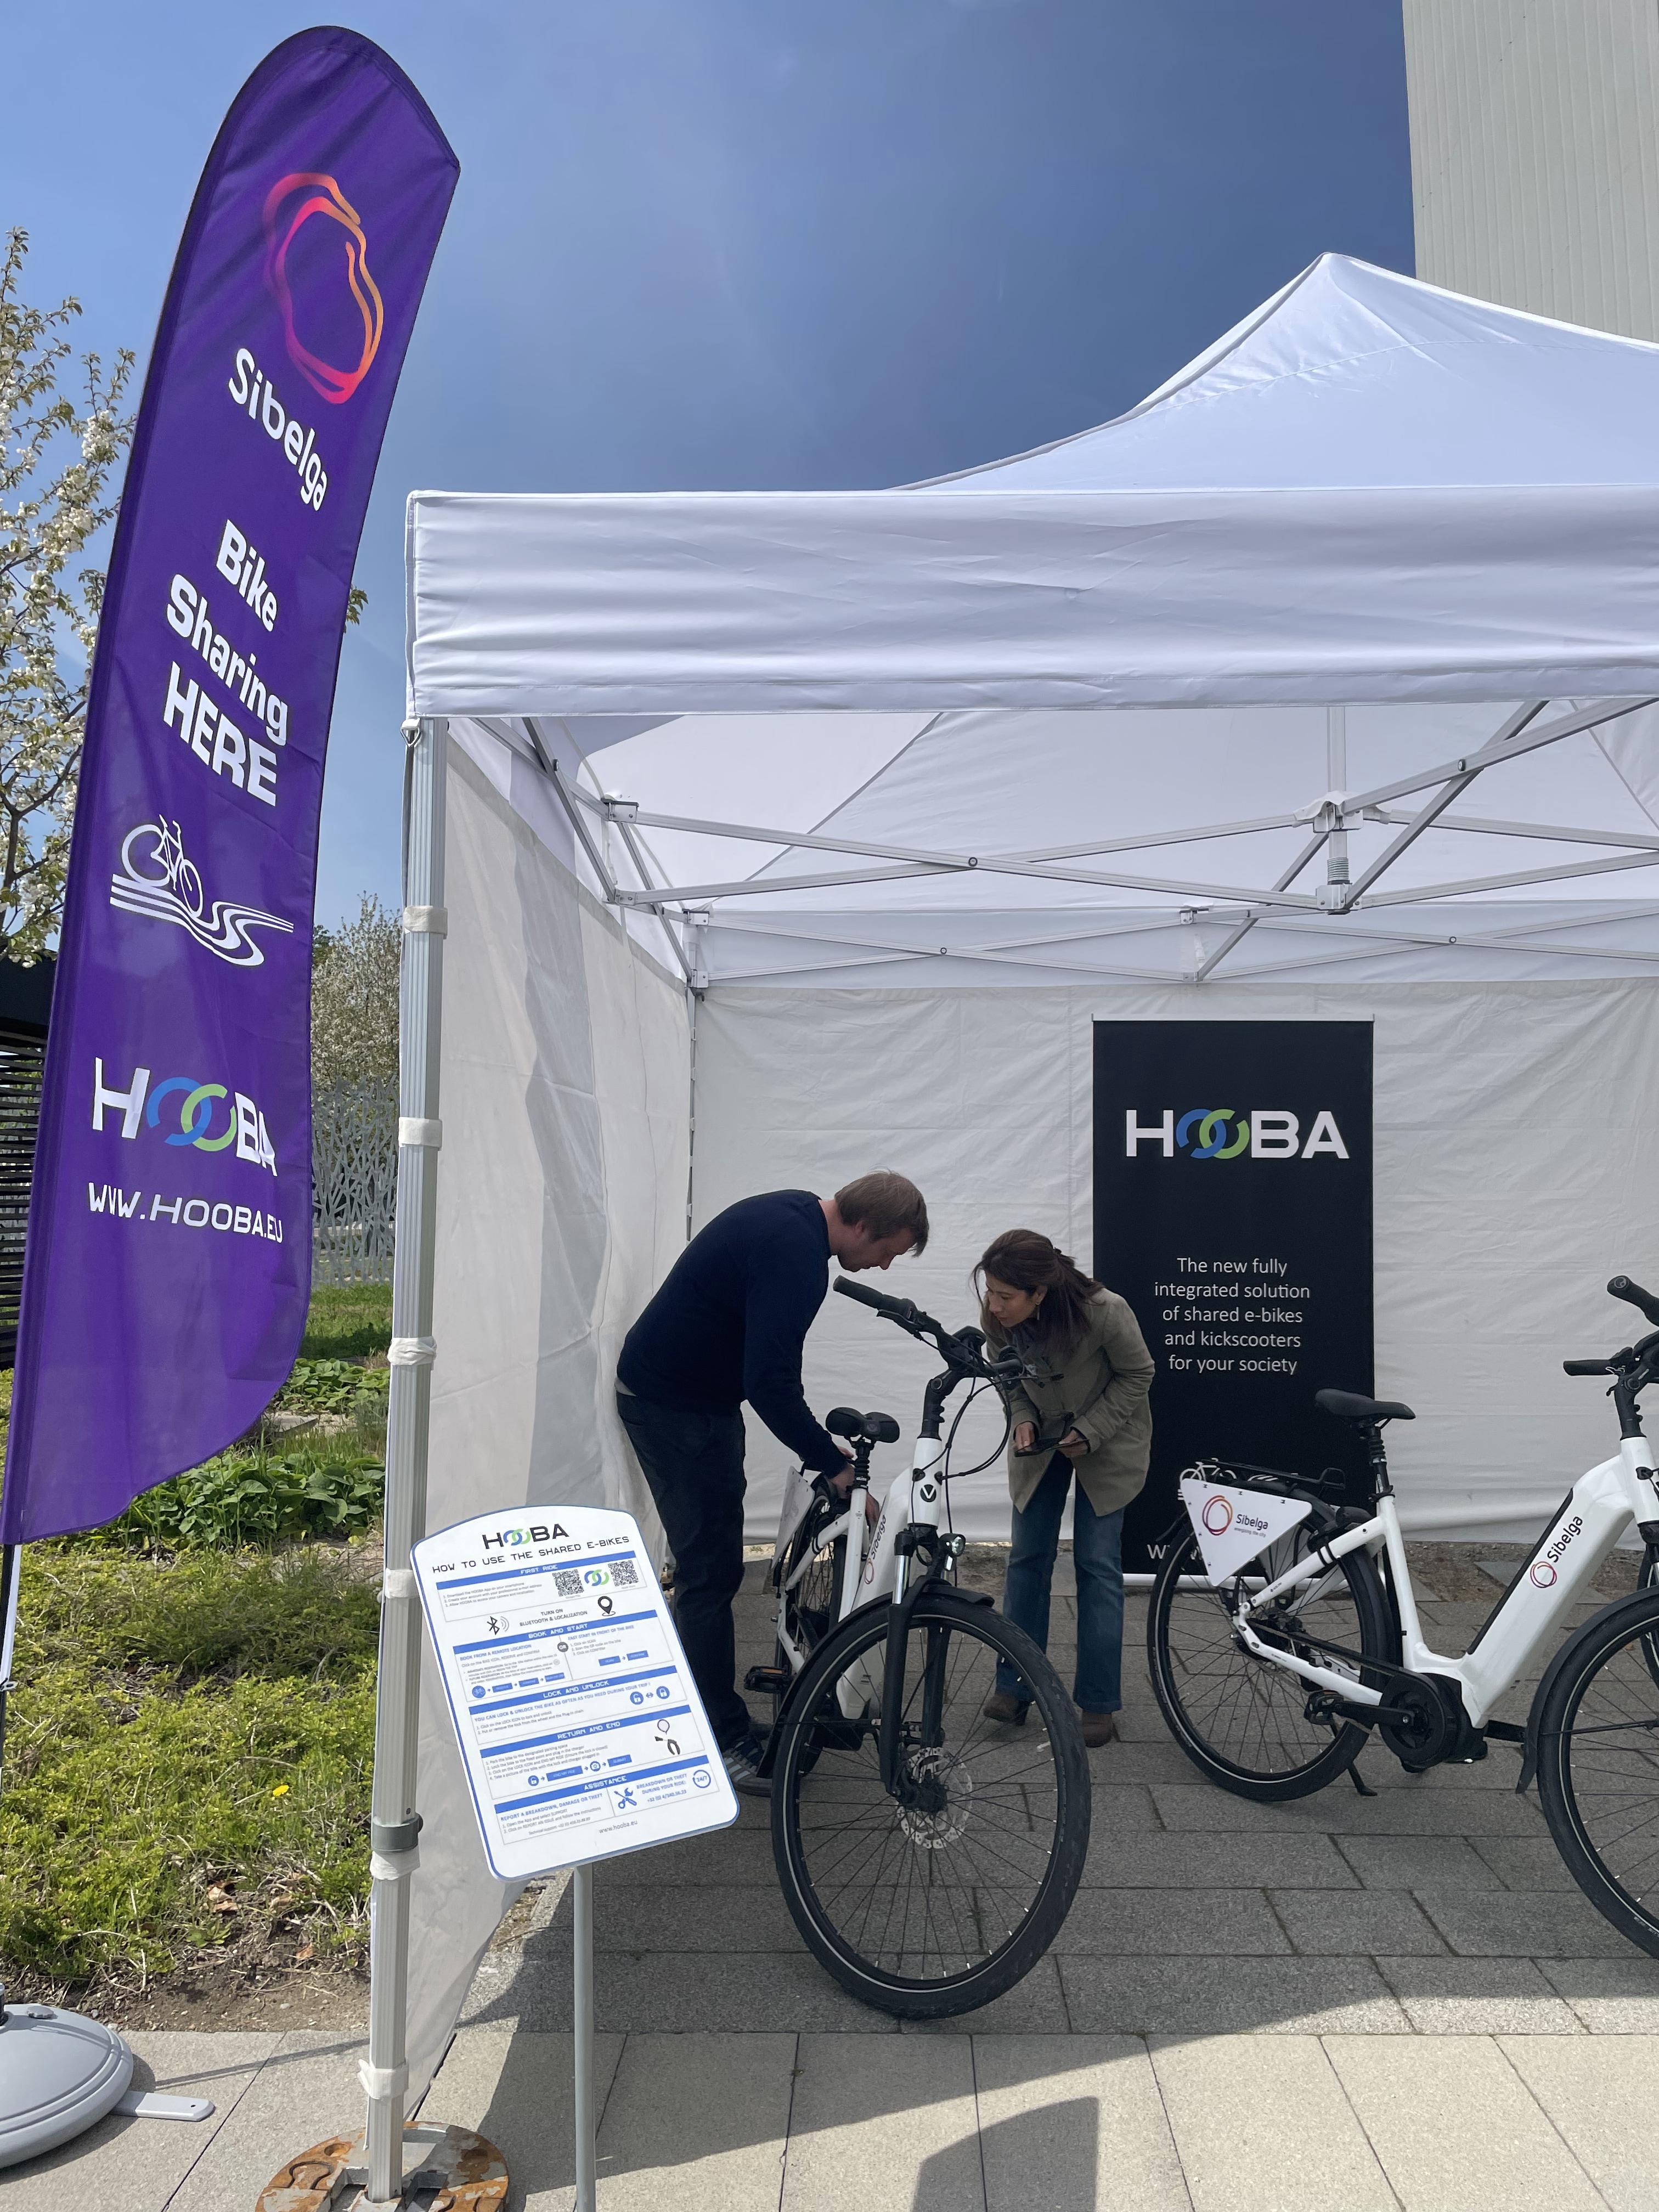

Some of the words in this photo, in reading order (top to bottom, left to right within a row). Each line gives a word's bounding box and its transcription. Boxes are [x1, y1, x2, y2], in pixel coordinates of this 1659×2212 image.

[228, 348, 328, 511] Sibelga
[216, 519, 278, 632] Bike
[167, 574, 289, 746] Sharing
[164, 661, 278, 807] HERE
[92, 1057, 278, 1177] HOOBA
[1126, 1109, 1350, 1160] HOOBA
[1176, 1257, 1207, 1273] The
[1214, 1262, 1248, 1273] new
[1251, 1257, 1288, 1278] fully
[1154, 1282, 1239, 1300] integrated
[1244, 1283, 1310, 1299] solution
[1163, 1305, 1180, 1321] of
[1184, 1306, 1239, 1322] shared
[1245, 1307, 1303, 1323] e-bikes
[1165, 1330, 1195, 1346] and
[1201, 1330, 1301, 1348] kickscooters
[1169, 1354, 1193, 1370] for
[1197, 1359, 1235, 1374] your
[1239, 1356, 1297, 1376] society
[1236, 1514, 1268, 1531] Sibelga
[482, 1523, 568, 1549] HOOBA
[871, 1514, 887, 1560] Sibelga
[1547, 1516, 1583, 1564] Sibelga
[432, 1563, 454, 1573] HOW
[482, 1555, 505, 1565] USE
[510, 1551, 533, 1560] THE
[538, 1544, 581, 1556] SHARED
[586, 1536, 629, 1548] E-BIKES
[519, 1618, 548, 1626] BLUETOOTH
[554, 1610, 588, 1620] LOCALIZATION
[543, 1690, 562, 1698] LOCK
[582, 1680, 609, 1690] UNLOCK
[557, 1729, 586, 1739] RETURN
[584, 1775, 627, 1790] ASSISTANCE
[599, 1820, 637, 1833] www.hooba.eu
